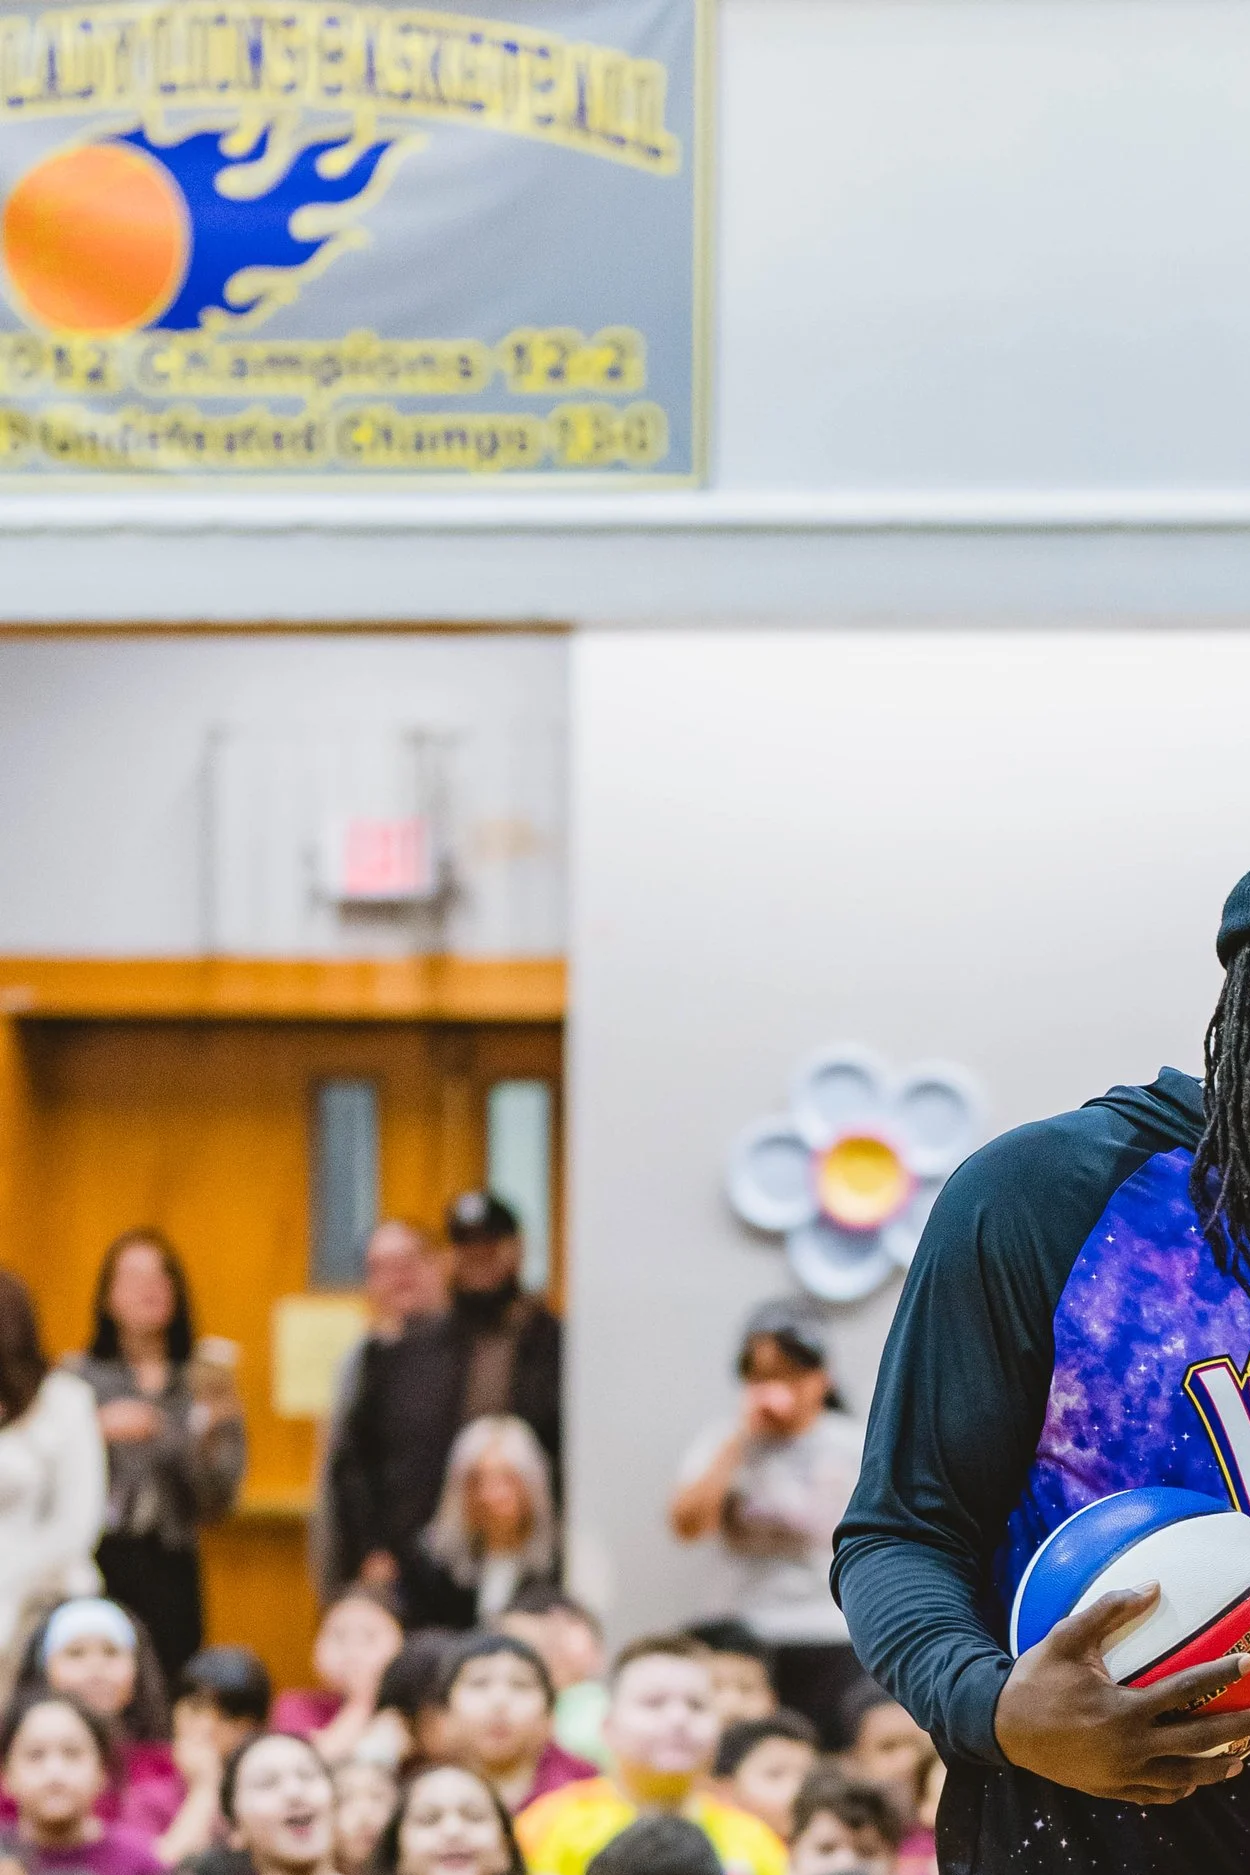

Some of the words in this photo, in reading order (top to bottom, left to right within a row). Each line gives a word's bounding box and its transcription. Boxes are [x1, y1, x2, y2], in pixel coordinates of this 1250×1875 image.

[306, 3, 682, 175] BASKETBALL
[135, 330, 491, 407] Champions
[503, 328, 646, 392] 12-2
[336, 403, 545, 472] Champs
